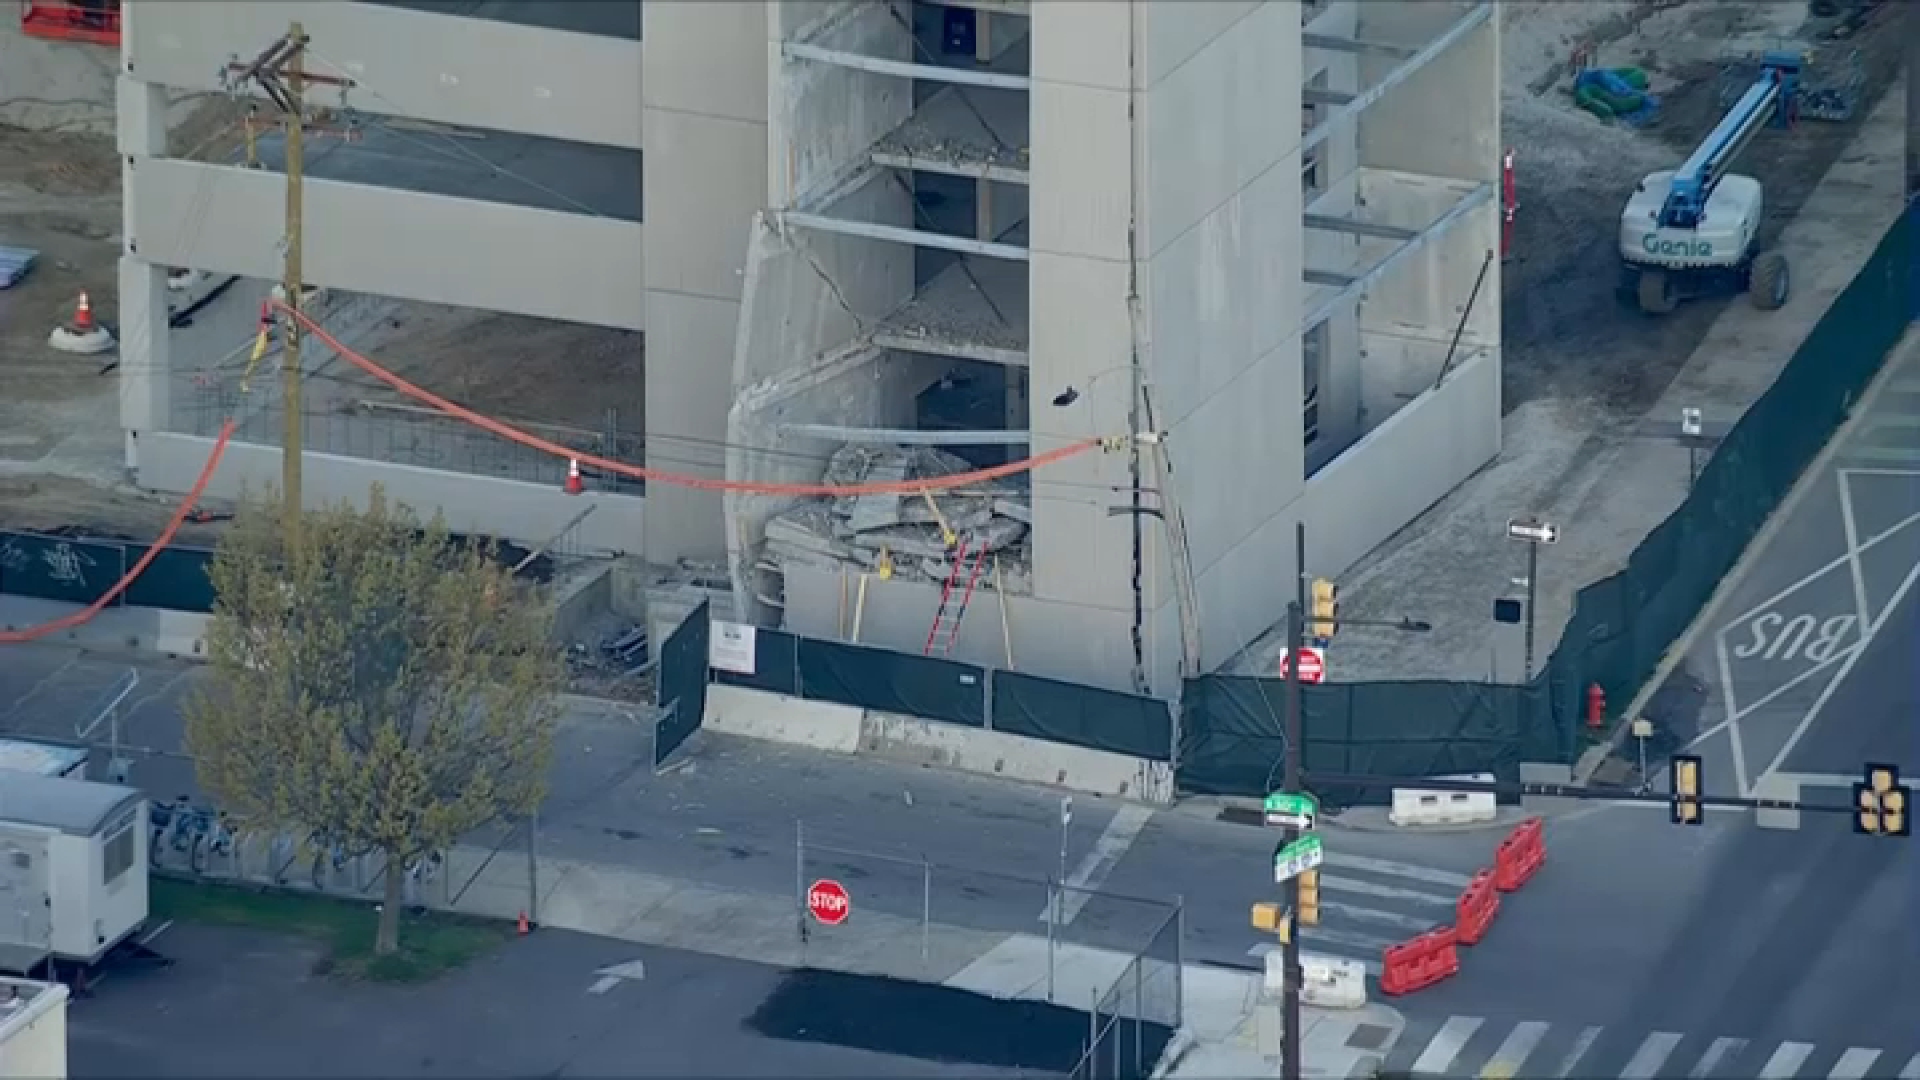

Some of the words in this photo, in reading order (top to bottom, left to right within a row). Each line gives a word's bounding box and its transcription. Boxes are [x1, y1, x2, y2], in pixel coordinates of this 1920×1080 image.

[1642, 233, 1713, 257] Genie
[1734, 611, 1857, 662] BUS
[811, 891, 847, 911] STOP
